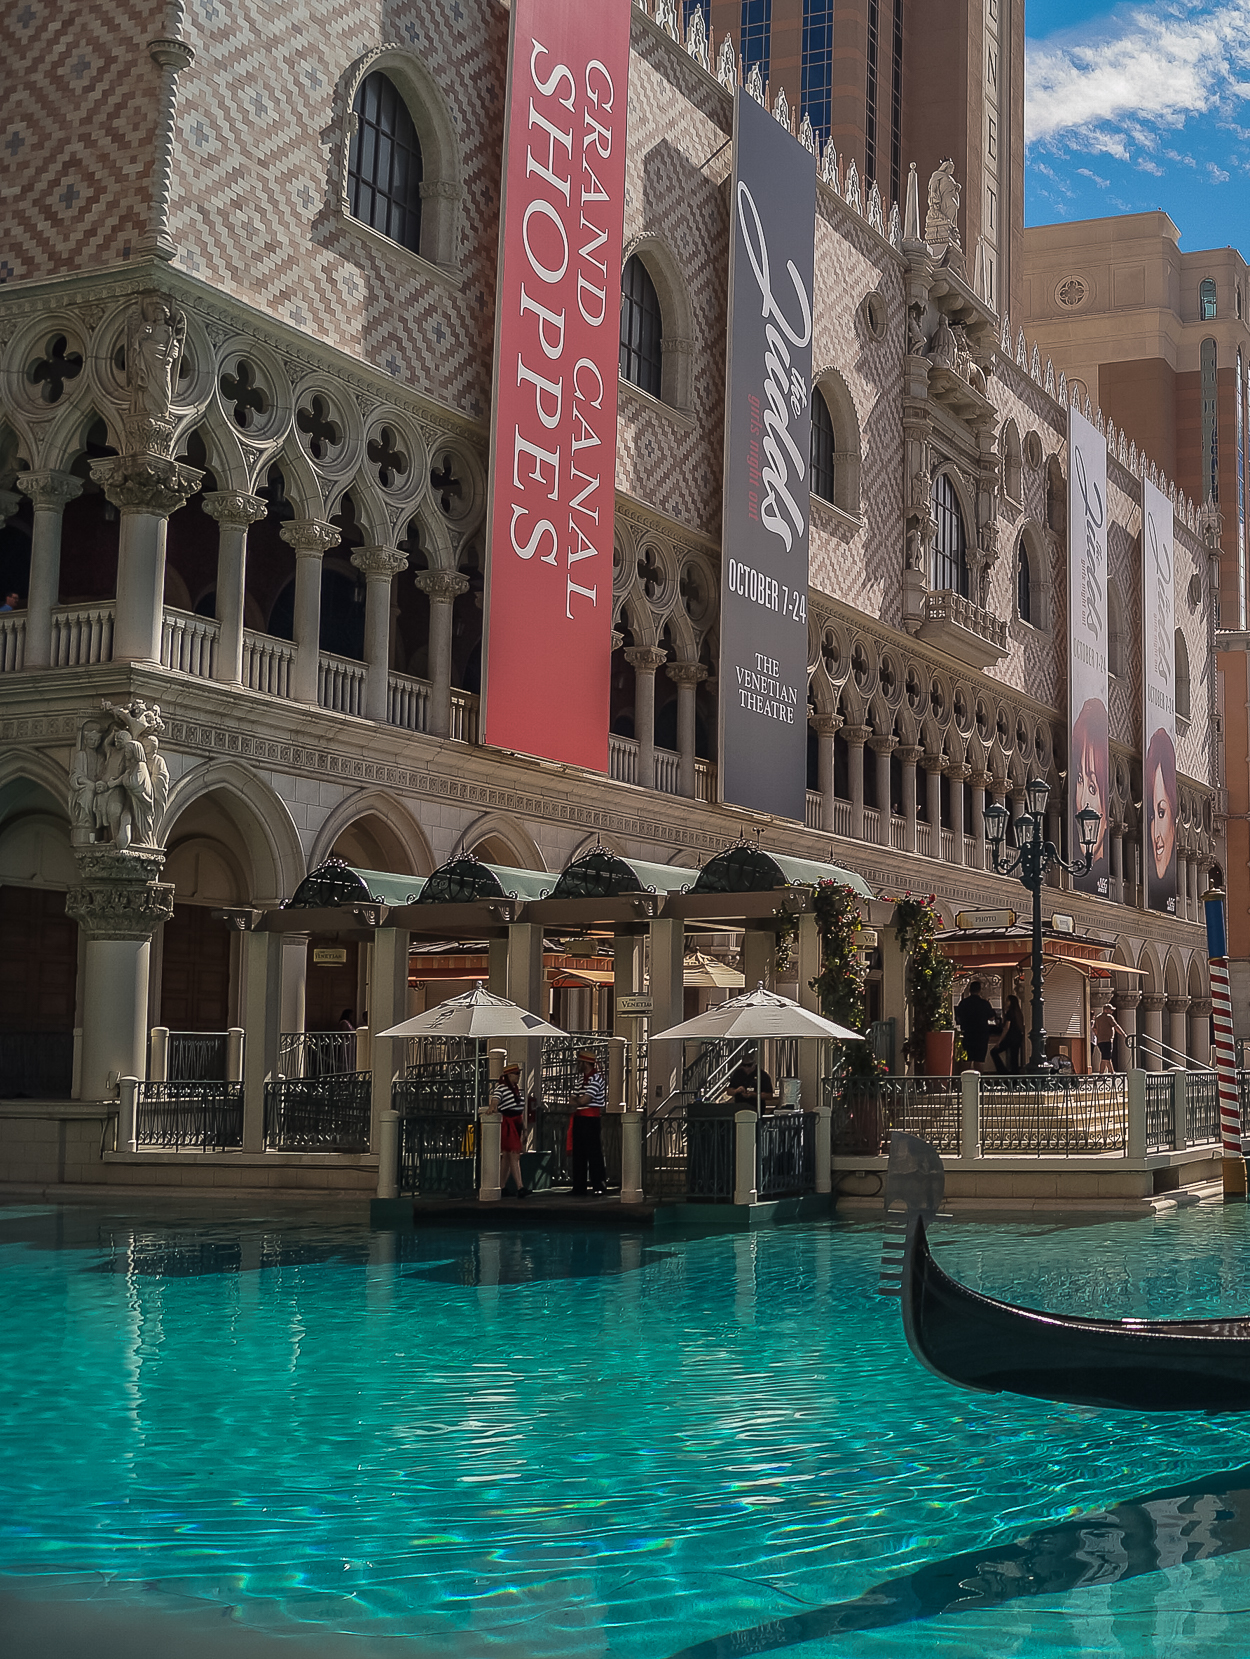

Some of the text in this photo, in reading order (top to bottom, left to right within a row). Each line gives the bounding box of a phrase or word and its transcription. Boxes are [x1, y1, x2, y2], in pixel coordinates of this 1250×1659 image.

[510, 37, 576, 567] SHOPPES
[566, 59, 614, 620] GRAND CANAL
[737, 181, 812, 553] Judds
[746, 394, 763, 521] girls night out
[728, 558, 807, 625] OCTOBER 7-24
[735, 665, 798, 705] VENETIAN
[738, 688, 794, 725] THEATRE
[754, 652, 780, 678] THE
